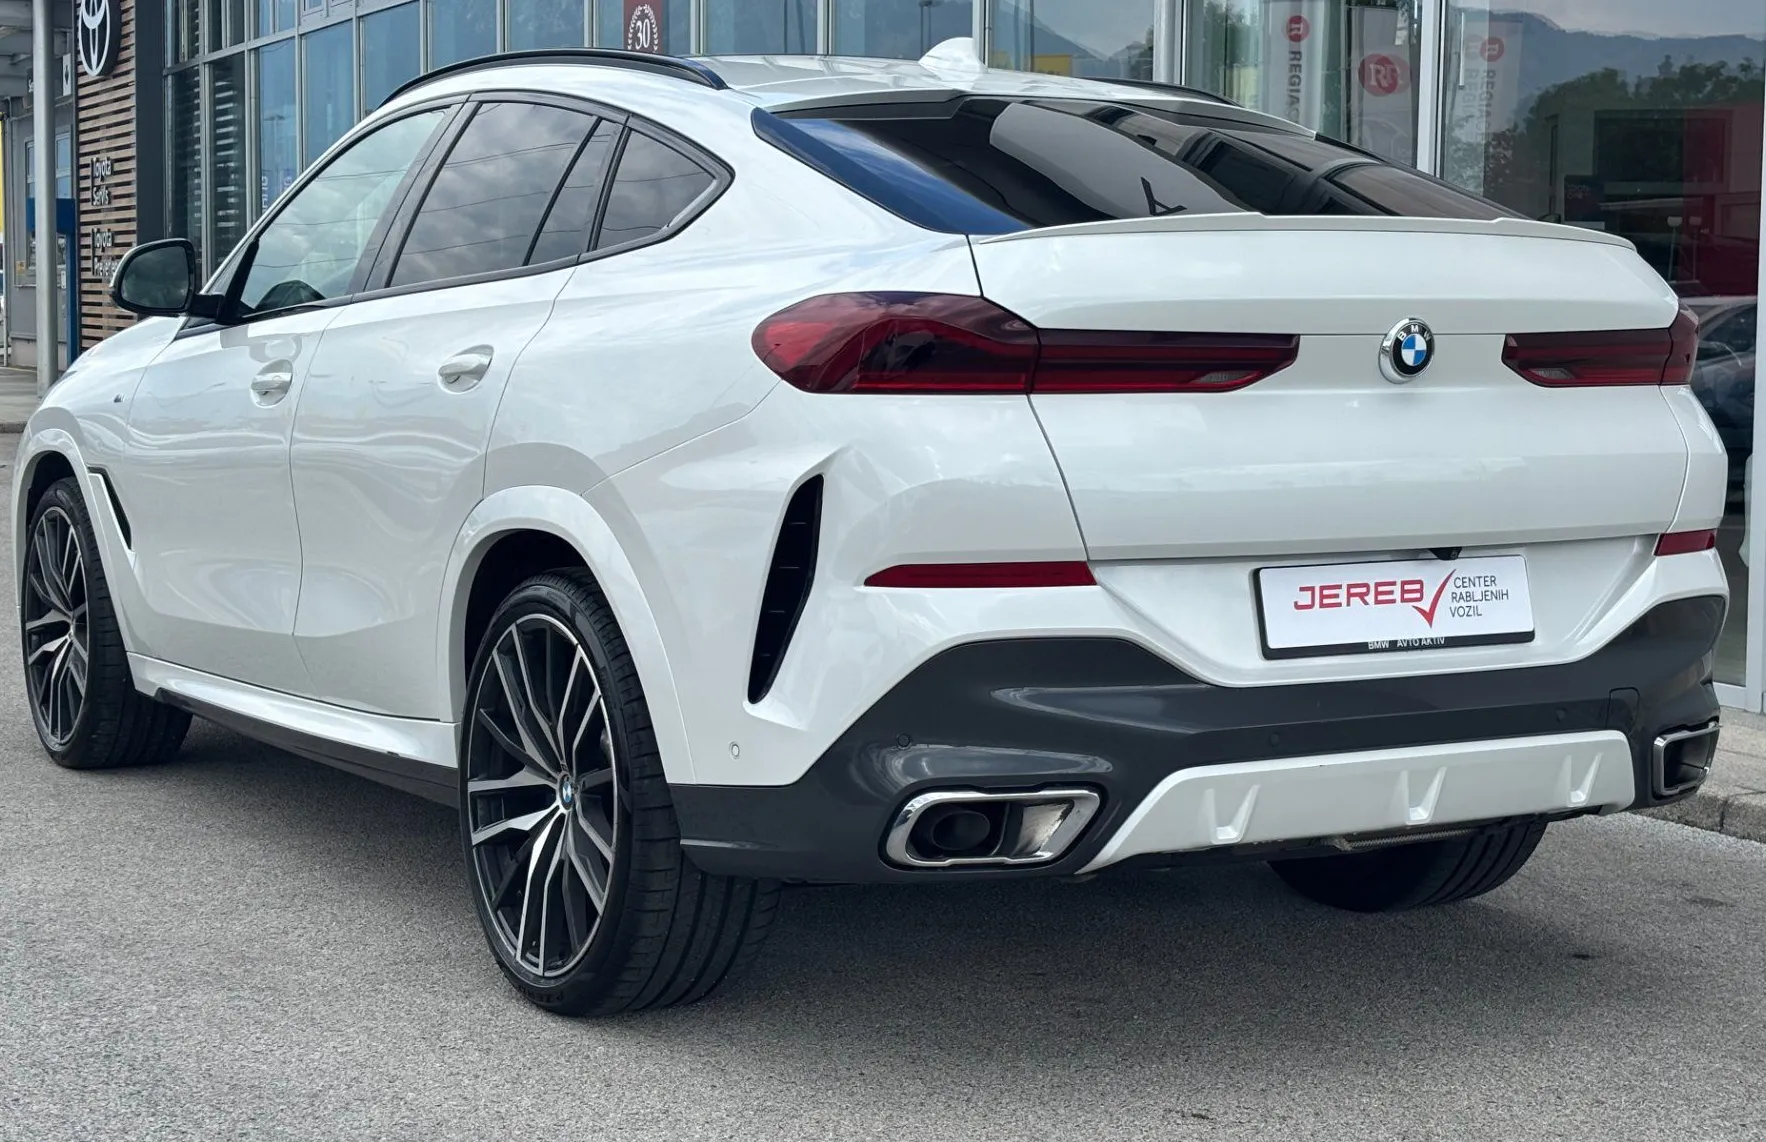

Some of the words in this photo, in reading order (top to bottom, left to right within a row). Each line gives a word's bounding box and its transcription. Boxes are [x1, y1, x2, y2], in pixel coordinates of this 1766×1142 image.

[635, 18, 650, 50] 30
[93, 158, 112, 179] Toyota
[92, 186, 110, 206] Servis
[94, 228, 112, 250] Toyota
[1453, 575, 1497, 589] CENTER
[1294, 579, 1424, 611] JEREB
[1451, 589, 1509, 603] RABLJENIH
[1449, 605, 1482, 618] VOZIL
[1368, 640, 1389, 650] BMW
[1396, 638, 1419, 648] AVTO
[1421, 636, 1445, 646] AKTIV
